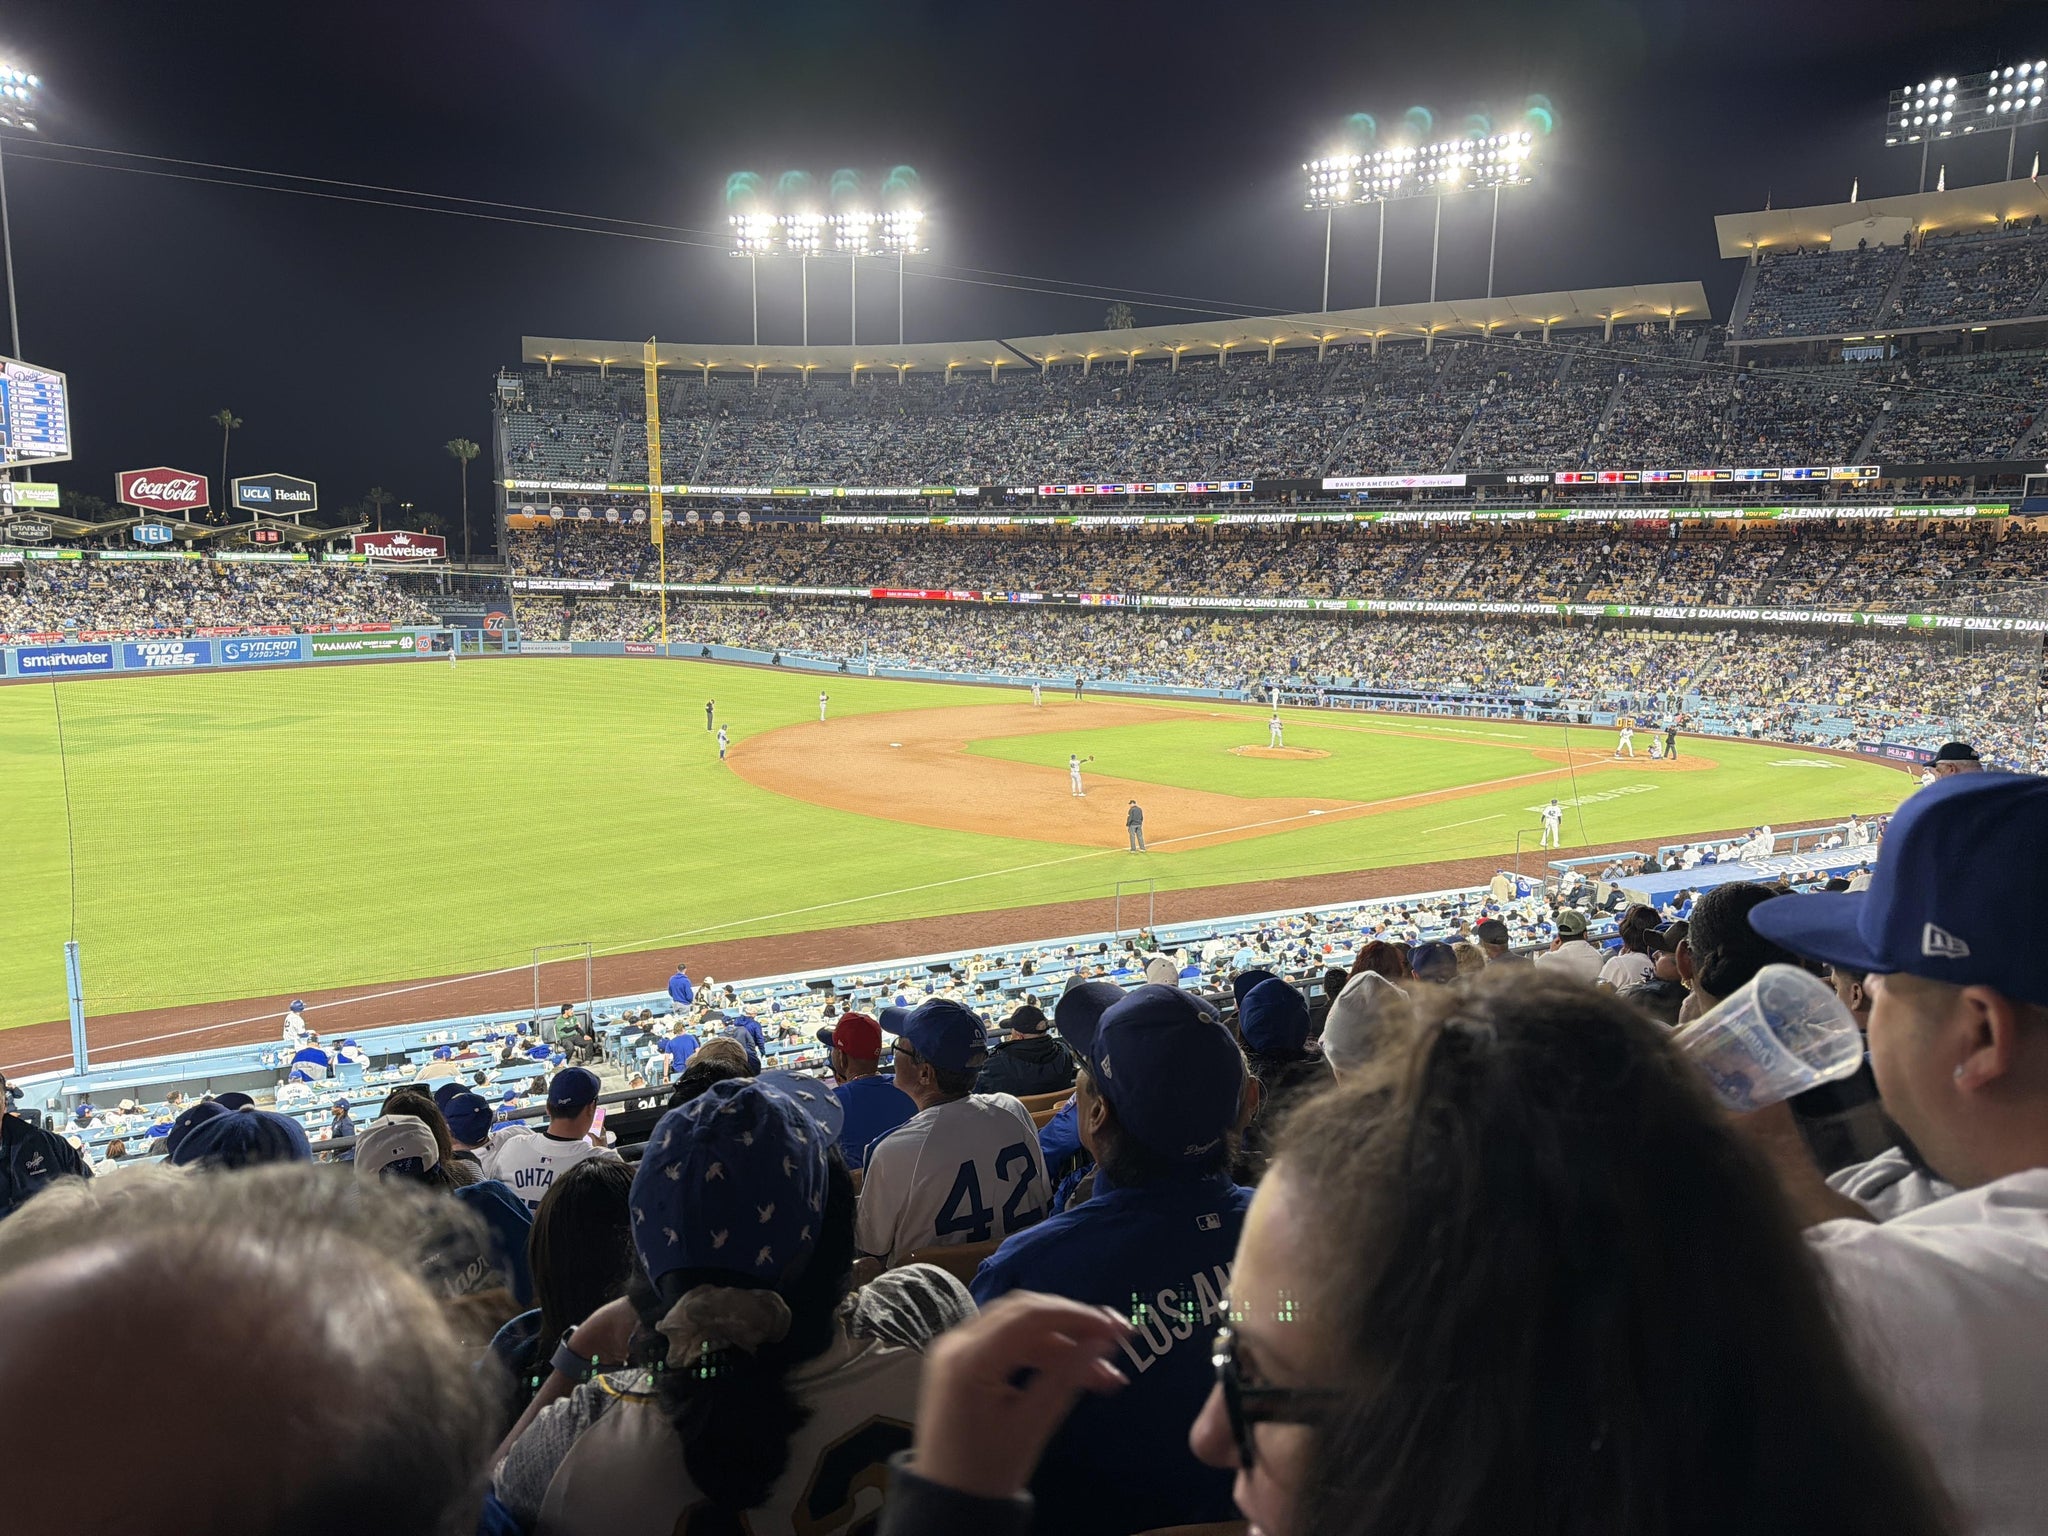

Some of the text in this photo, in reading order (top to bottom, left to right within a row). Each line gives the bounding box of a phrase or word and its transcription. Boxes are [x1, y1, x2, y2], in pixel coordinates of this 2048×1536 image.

[130, 477, 200, 501] Coca-Cola
[243, 489, 311, 501] UCLA Health
[688, 486, 711, 494] VOTED
[1227, 514, 1296, 522] LENNY KRAVITZ
[1390, 511, 1471, 521] LENNY KRAVITZ
[1577, 509, 1669, 519] LENNY KRAVITZ
[1791, 507, 1894, 518] LENNY KRAVITZ
[1083, 516, 1145, 524] LENNY KRAVITZ
[138, 527, 167, 540] TEL
[364, 543, 437, 557] Budweiser
[1151, 597, 1167, 605] THE
[1168, 597, 1191, 606] ONLY
[1198, 598, 1242, 606] DIAMOND
[1243, 599, 1277, 607] CASINO
[1279, 599, 1309, 607] HOTEL
[1367, 601, 1559, 613] THE ONLY 5 DIAMOND CASINO HOTEL
[1629, 606, 1855, 623] THE ONLY 5 DIAMOND CASINO HOTEL
[487, 617, 505, 630] 76
[1935, 617, 1962, 627] THE
[1964, 618, 2001, 629] ONLY
[2003, 619, 2012, 629] 5
[136, 643, 184, 655] TOYO
[240, 640, 297, 652] SYNCRON
[418, 640, 429, 648] 76
[626, 644, 655, 652] Yakult
[22, 652, 107, 667] smartwater
[145, 653, 196, 666] TIRES
[973, 964, 985, 972] 42
[935, 1142, 1042, 1244] 42
[1117, 1288, 1193, 1374] LOS
